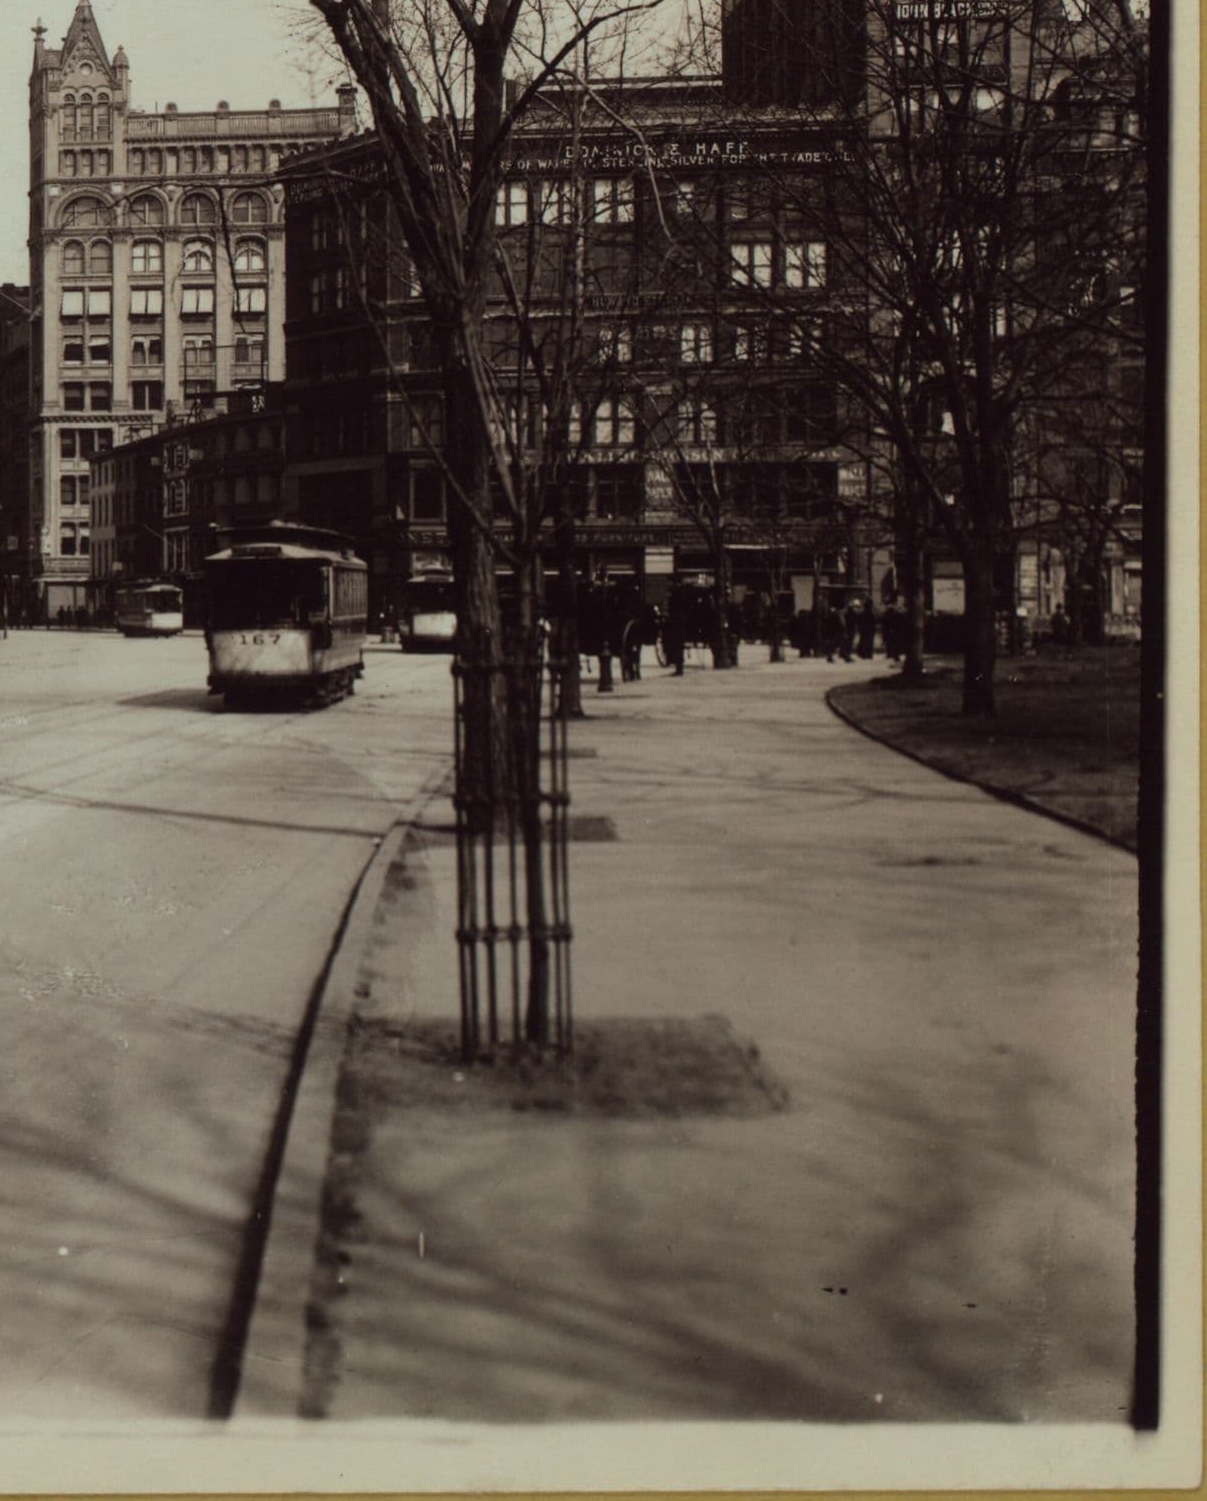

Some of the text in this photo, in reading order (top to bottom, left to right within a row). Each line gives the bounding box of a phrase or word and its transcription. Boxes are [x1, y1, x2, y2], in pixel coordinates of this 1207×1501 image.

[695, 141, 749, 156] HAFF
[537, 158, 572, 170] WARE
[239, 633, 282, 646] 167
